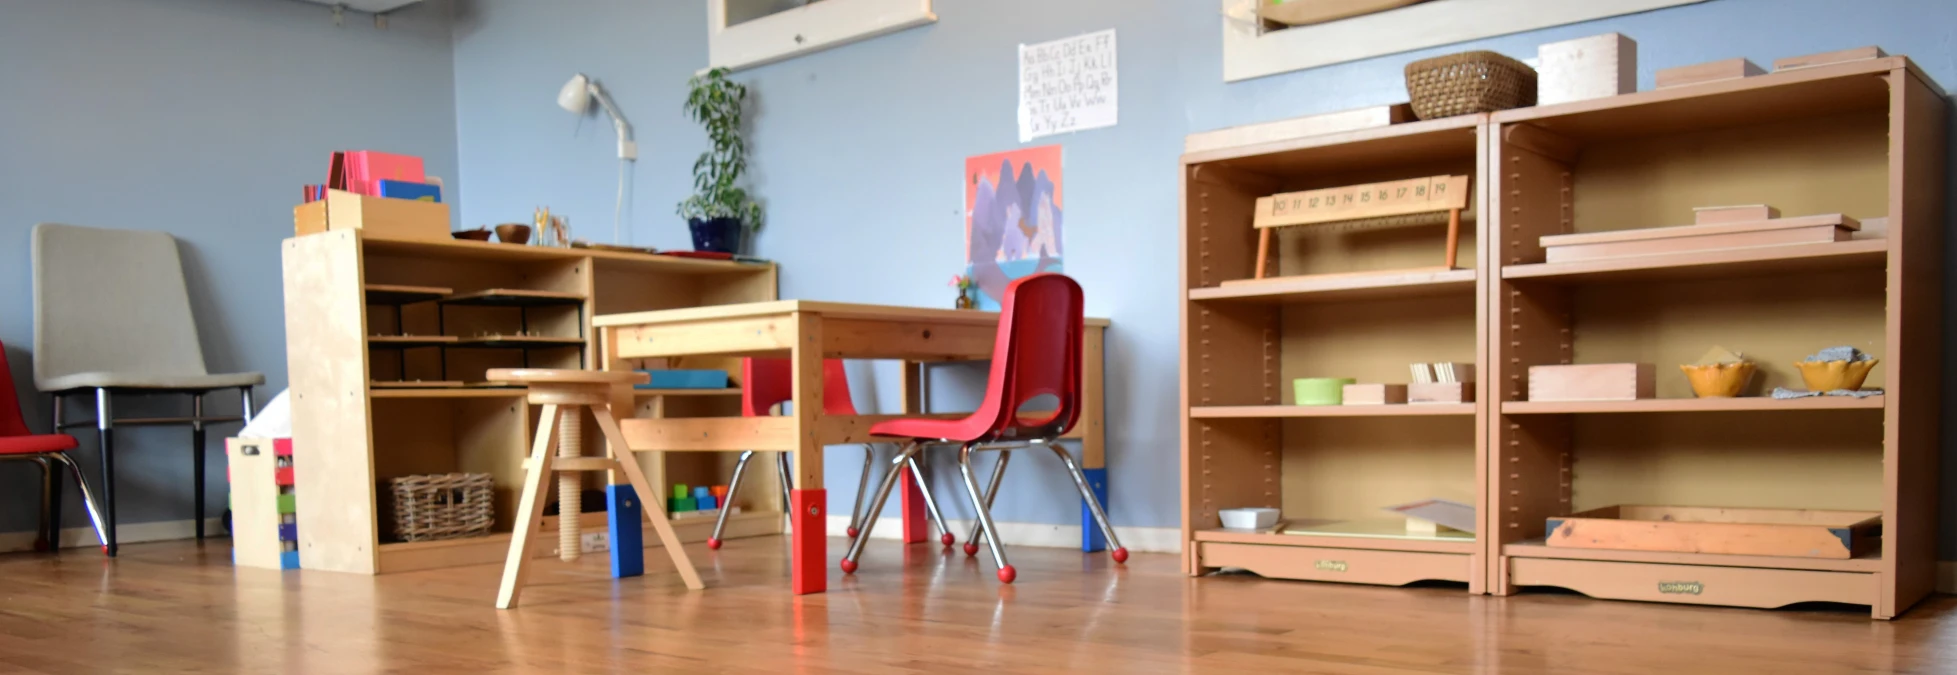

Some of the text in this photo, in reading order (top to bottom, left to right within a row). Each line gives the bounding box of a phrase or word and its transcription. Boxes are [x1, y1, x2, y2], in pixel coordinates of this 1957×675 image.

[1063, 40, 1076, 58] Dd
[1095, 34, 1109, 51] Ff
[1084, 56, 1097, 70] Kk
[1059, 79, 1072, 94] Oo
[1043, 115, 1057, 133] Yy
[1060, 111, 1076, 128] Zz
[1275, 183, 1447, 210] 10 11 12 13 14 15 16 17 18 19
